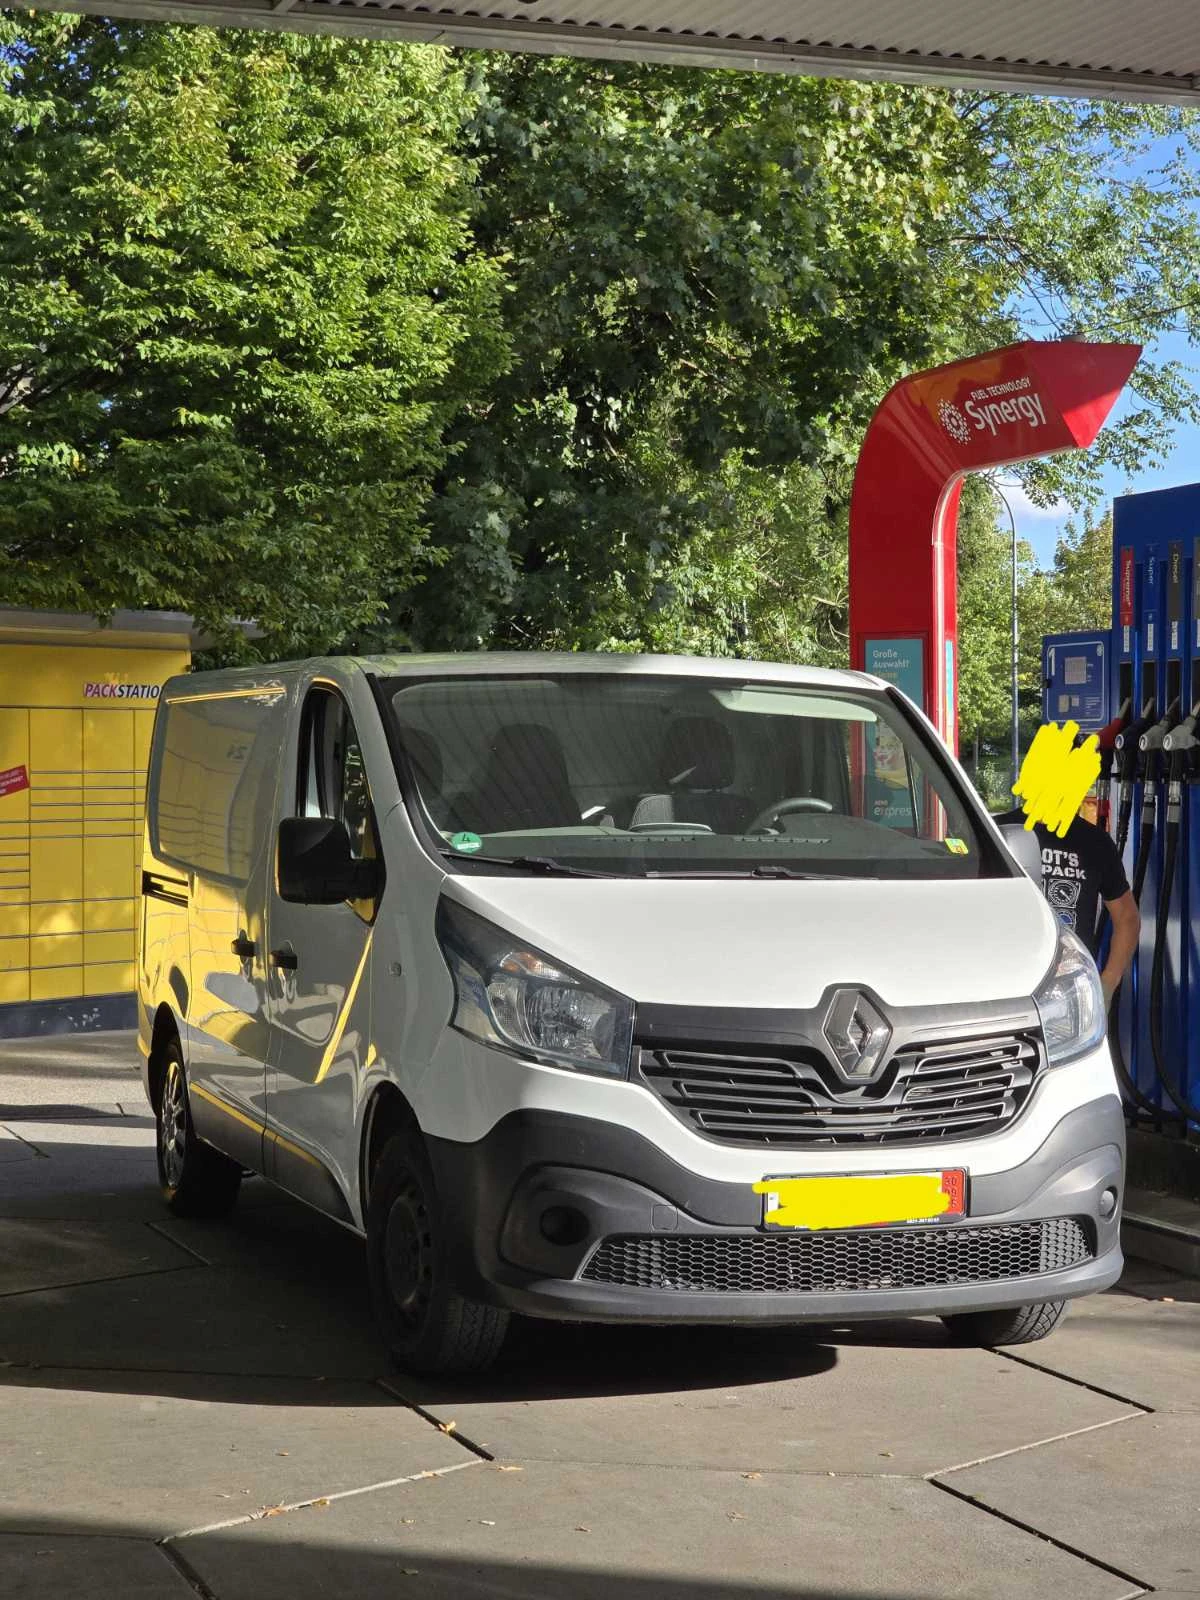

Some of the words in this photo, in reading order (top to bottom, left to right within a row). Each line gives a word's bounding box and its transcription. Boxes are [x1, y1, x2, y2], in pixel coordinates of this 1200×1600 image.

[970, 390, 989, 400] FUEL
[986, 377, 1031, 397] TECHNOLOGY
[965, 393, 1046, 436] Synergy
[872, 649, 898, 658] Große
[84, 683, 160, 699] PACKSTATIO
[1041, 864, 1086, 879] PACK
